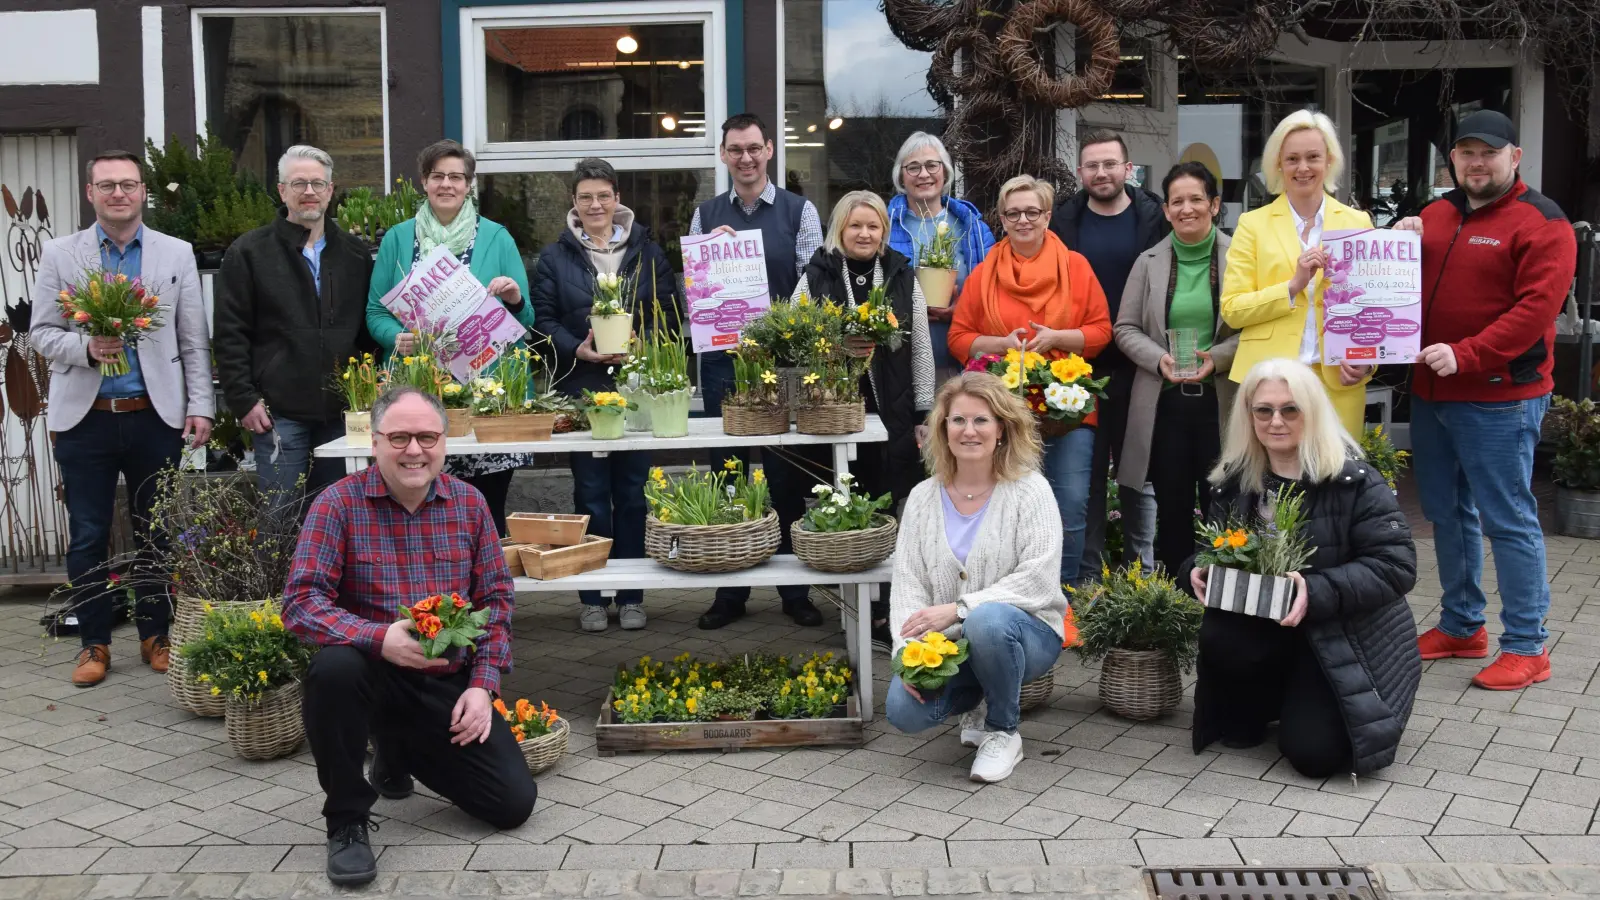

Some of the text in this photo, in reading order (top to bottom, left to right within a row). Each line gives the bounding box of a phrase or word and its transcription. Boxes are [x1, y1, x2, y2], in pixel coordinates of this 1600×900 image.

[700, 240, 763, 262] BRAKEL
[1343, 240, 1418, 261] BRAKEL
[401, 256, 461, 308] BRAKEL
[1395, 267, 1418, 281] auf
[1365, 280, 1415, 290] 16.04.2024
[442, 283, 478, 315] 16.04.2024
